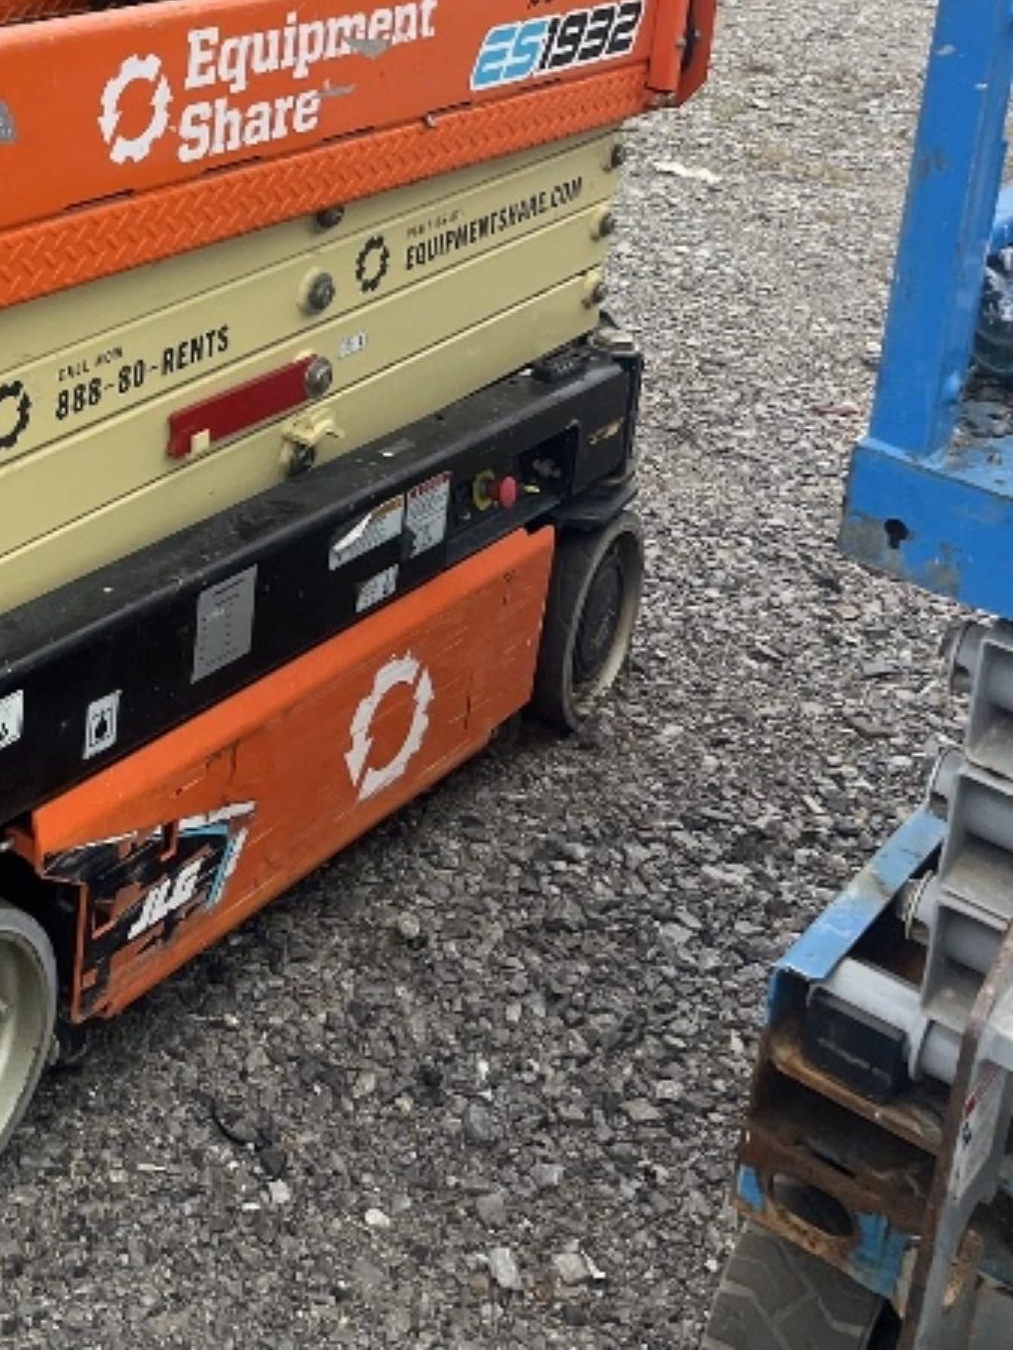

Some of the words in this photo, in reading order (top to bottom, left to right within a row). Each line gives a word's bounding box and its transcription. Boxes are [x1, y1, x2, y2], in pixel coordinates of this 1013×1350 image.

[178, 88, 322, 164] Share
[406, 176, 583, 270] EQUIPMENTSHARE.COM
[55, 323, 230, 421] 888-80-RENTS
